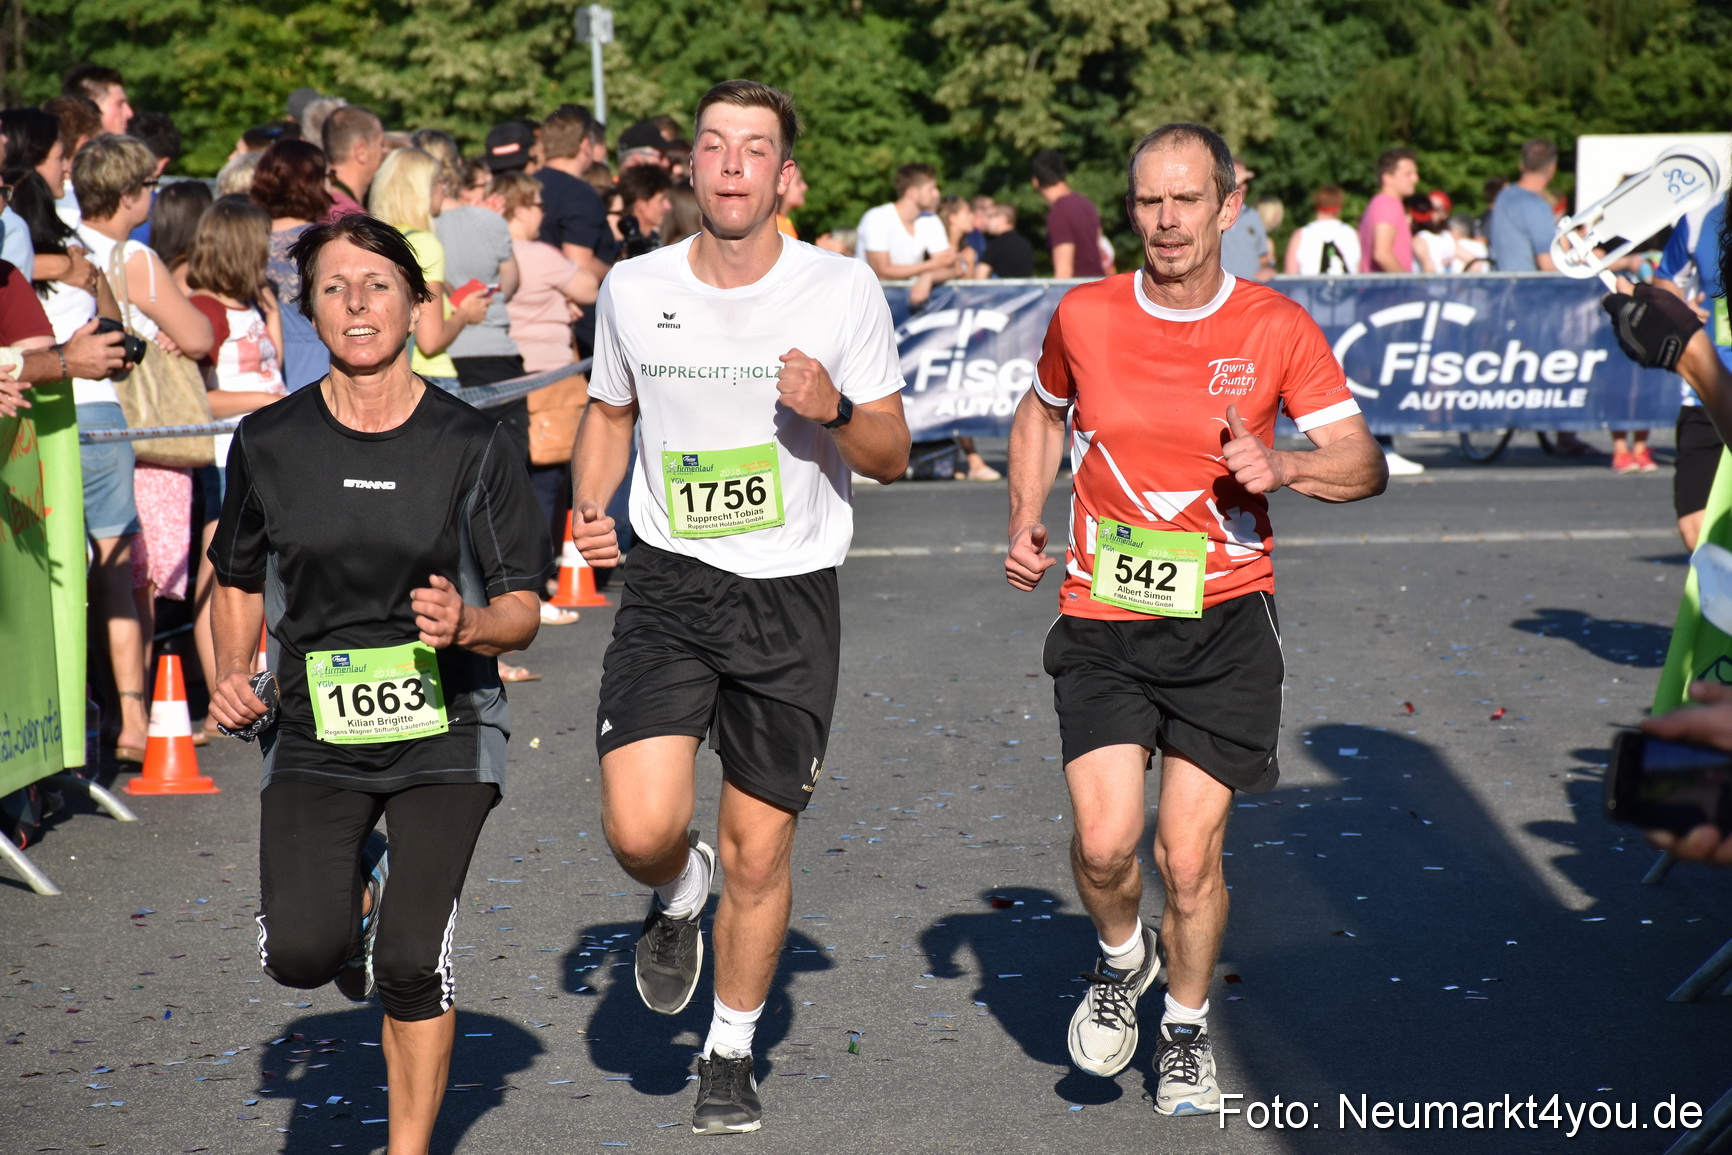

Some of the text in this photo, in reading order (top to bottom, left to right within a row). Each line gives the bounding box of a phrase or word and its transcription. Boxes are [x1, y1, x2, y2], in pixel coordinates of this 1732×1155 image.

[657, 322, 681, 330] erima
[1208, 358, 1255, 375] Town &
[1379, 339, 1608, 386] Fischer
[640, 363, 730, 379] RUPPRECHT
[1208, 373, 1257, 395] Country
[1224, 388, 1248, 396] HAUS
[935, 398, 1020, 417] AUTO
[1398, 388, 1588, 411] AUTOMOBILE
[676, 463, 714, 473] firmenlauf
[343, 479, 396, 490] STANNO
[679, 475, 767, 513] 1756
[686, 507, 764, 524] Rupprecht Tobias
[687, 520, 718, 530] Rupprecht
[719, 518, 744, 527] Holzbau
[745, 516, 764, 524] GmbH
[1109, 532, 1144, 548] firmenlauf
[1114, 554, 1178, 592] 542
[1117, 585, 1172, 601] Albert Simon
[1128, 596, 1154, 606] Hausbau
[324, 664, 367, 674] firmenlauf
[328, 677, 426, 718] 1663
[324, 729, 348, 737] Regens
[348, 727, 372, 736] Wagner
[374, 724, 400, 734] Stiftung
[400, 719, 439, 731] Lauterhofen
[347, 714, 414, 727] Kilian Brigitte
